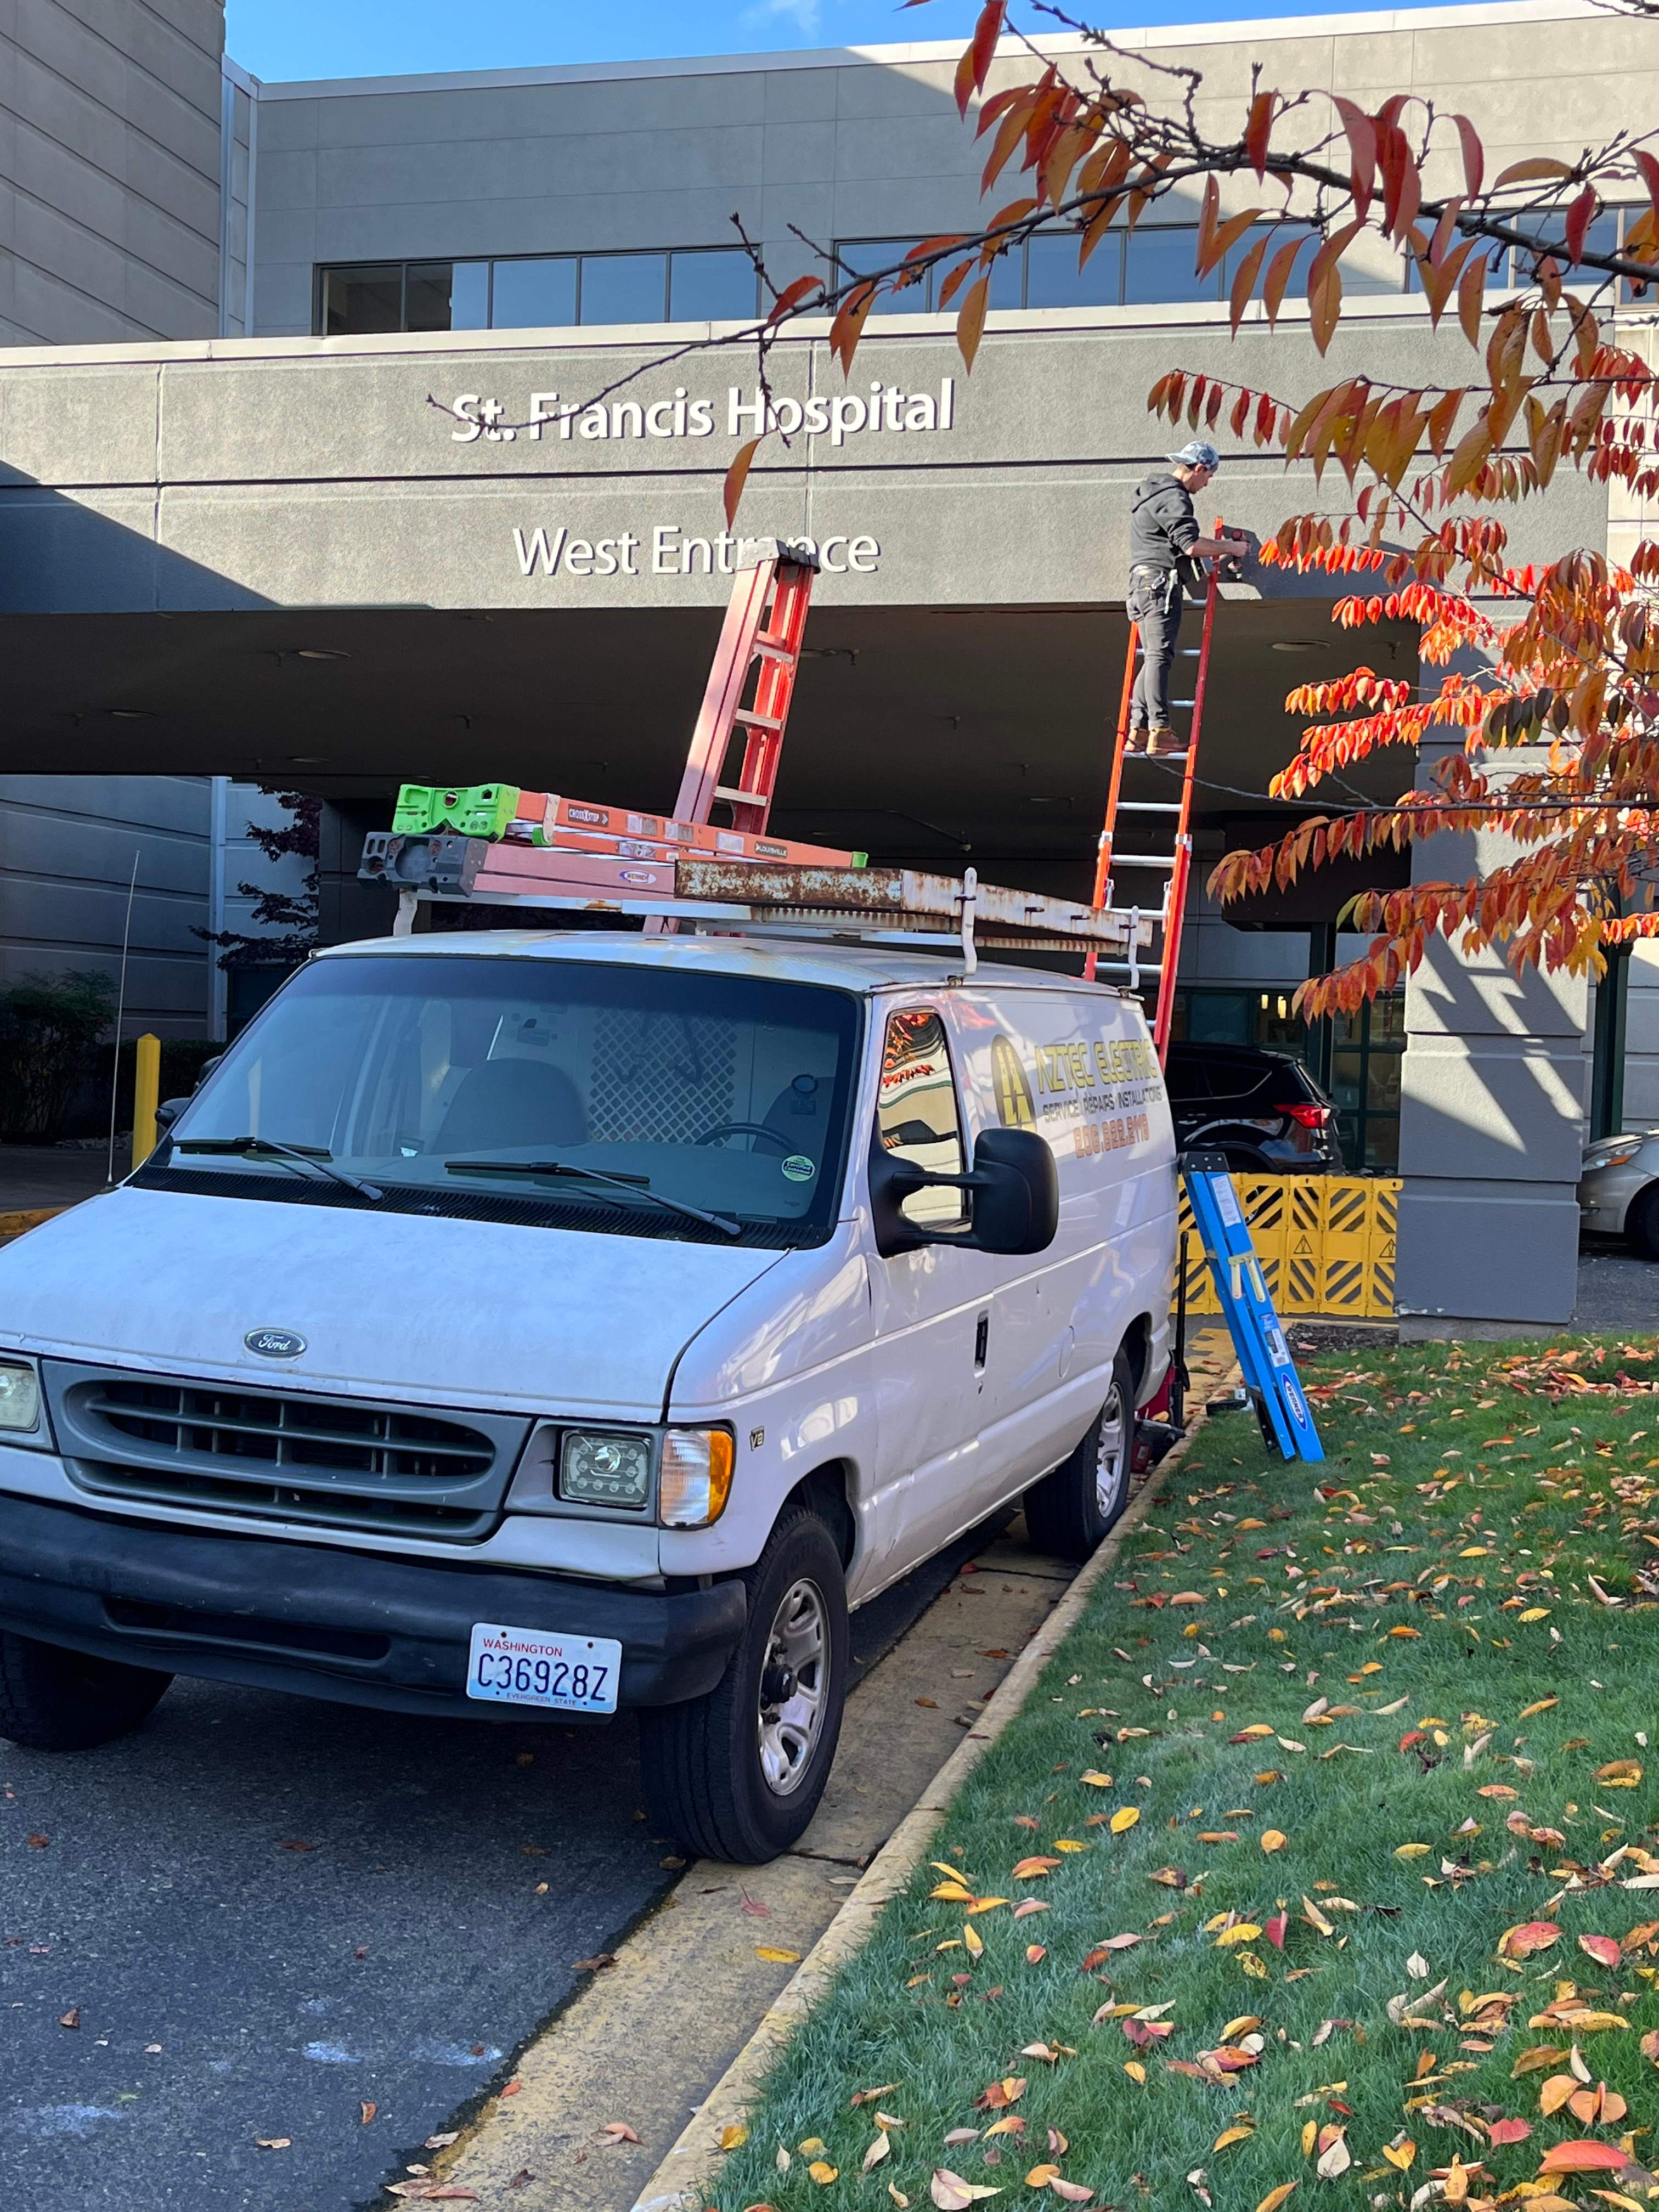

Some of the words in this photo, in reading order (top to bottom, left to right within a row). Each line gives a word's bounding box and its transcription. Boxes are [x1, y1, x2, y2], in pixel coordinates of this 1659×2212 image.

[451, 393, 515, 442] St.
[529, 387, 713, 440] Francis
[727, 377, 953, 445] Hospital
[512, 527, 640, 576] West
[759, 845, 787, 856] LOUISVILLE
[1094, 1039, 1157, 1085] ELECTRIC
[1043, 1099, 1080, 1122] SERVICE
[1083, 1093, 1115, 1115] REPAIRS
[258, 1334, 291, 1351] Ford
[1286, 1383, 1305, 1420] WERNER
[750, 1426, 764, 1451] V8
[483, 1638, 562, 1657] WASHINGTON
[478, 1653, 608, 1701] C36928Z
[506, 1692, 550, 1703] EVERGREEN
[554, 1697, 576, 1706] STATE
